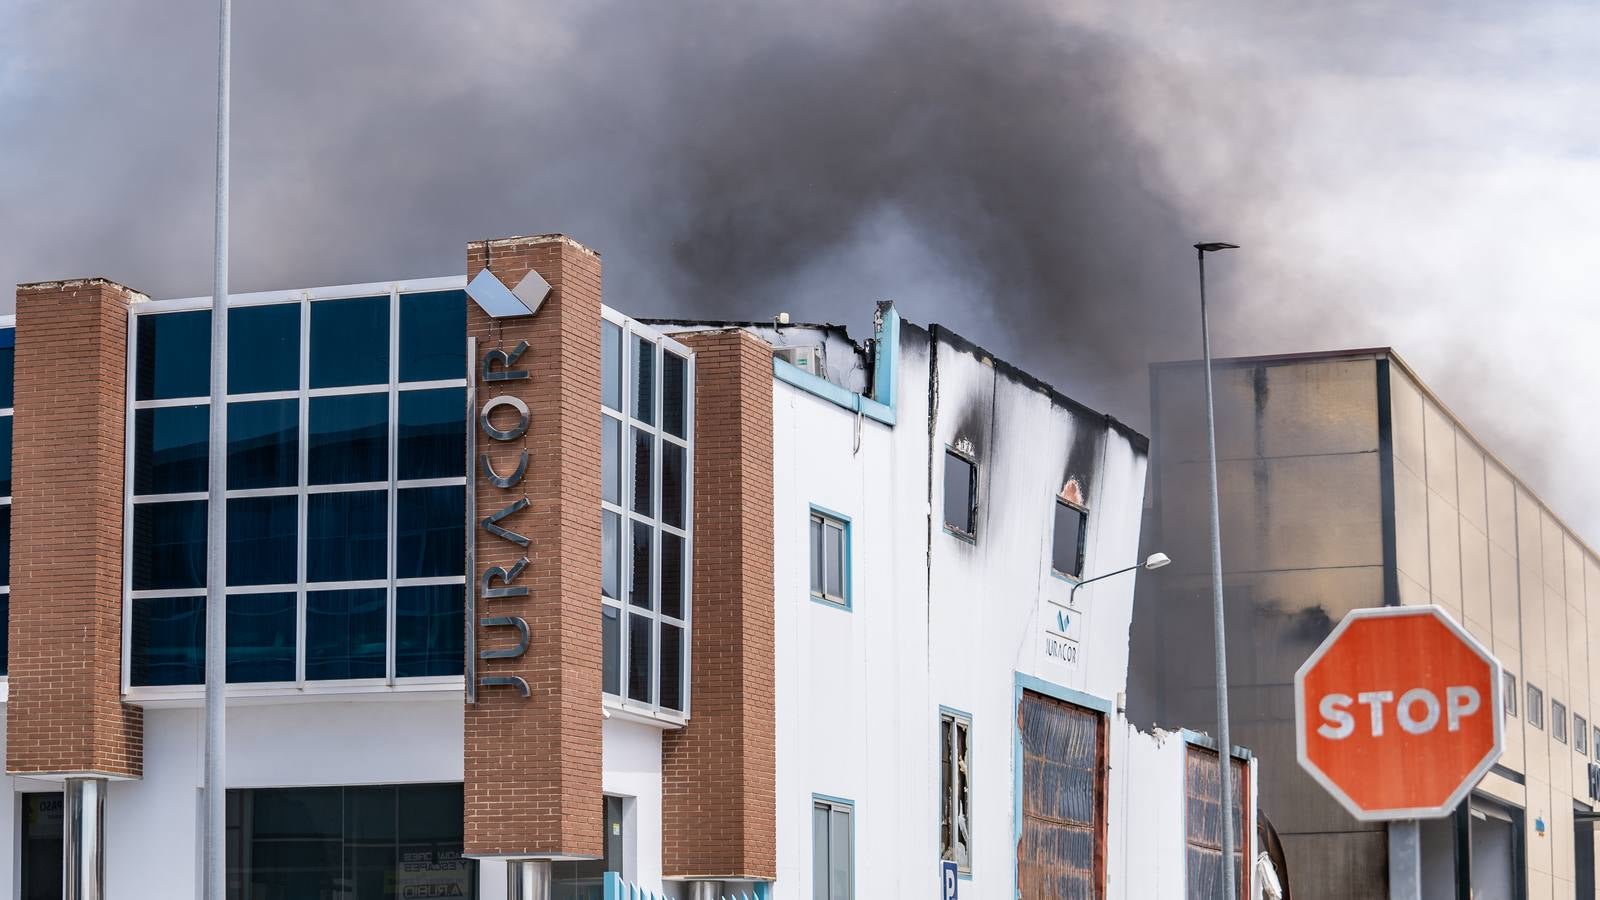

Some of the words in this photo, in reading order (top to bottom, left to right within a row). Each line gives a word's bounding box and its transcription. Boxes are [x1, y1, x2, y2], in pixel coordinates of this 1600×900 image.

[480, 340, 530, 698] JURACOR
[1045, 638, 1077, 663] JURACOR
[1317, 685, 1481, 740] STOP
[945, 869, 955, 900] P
